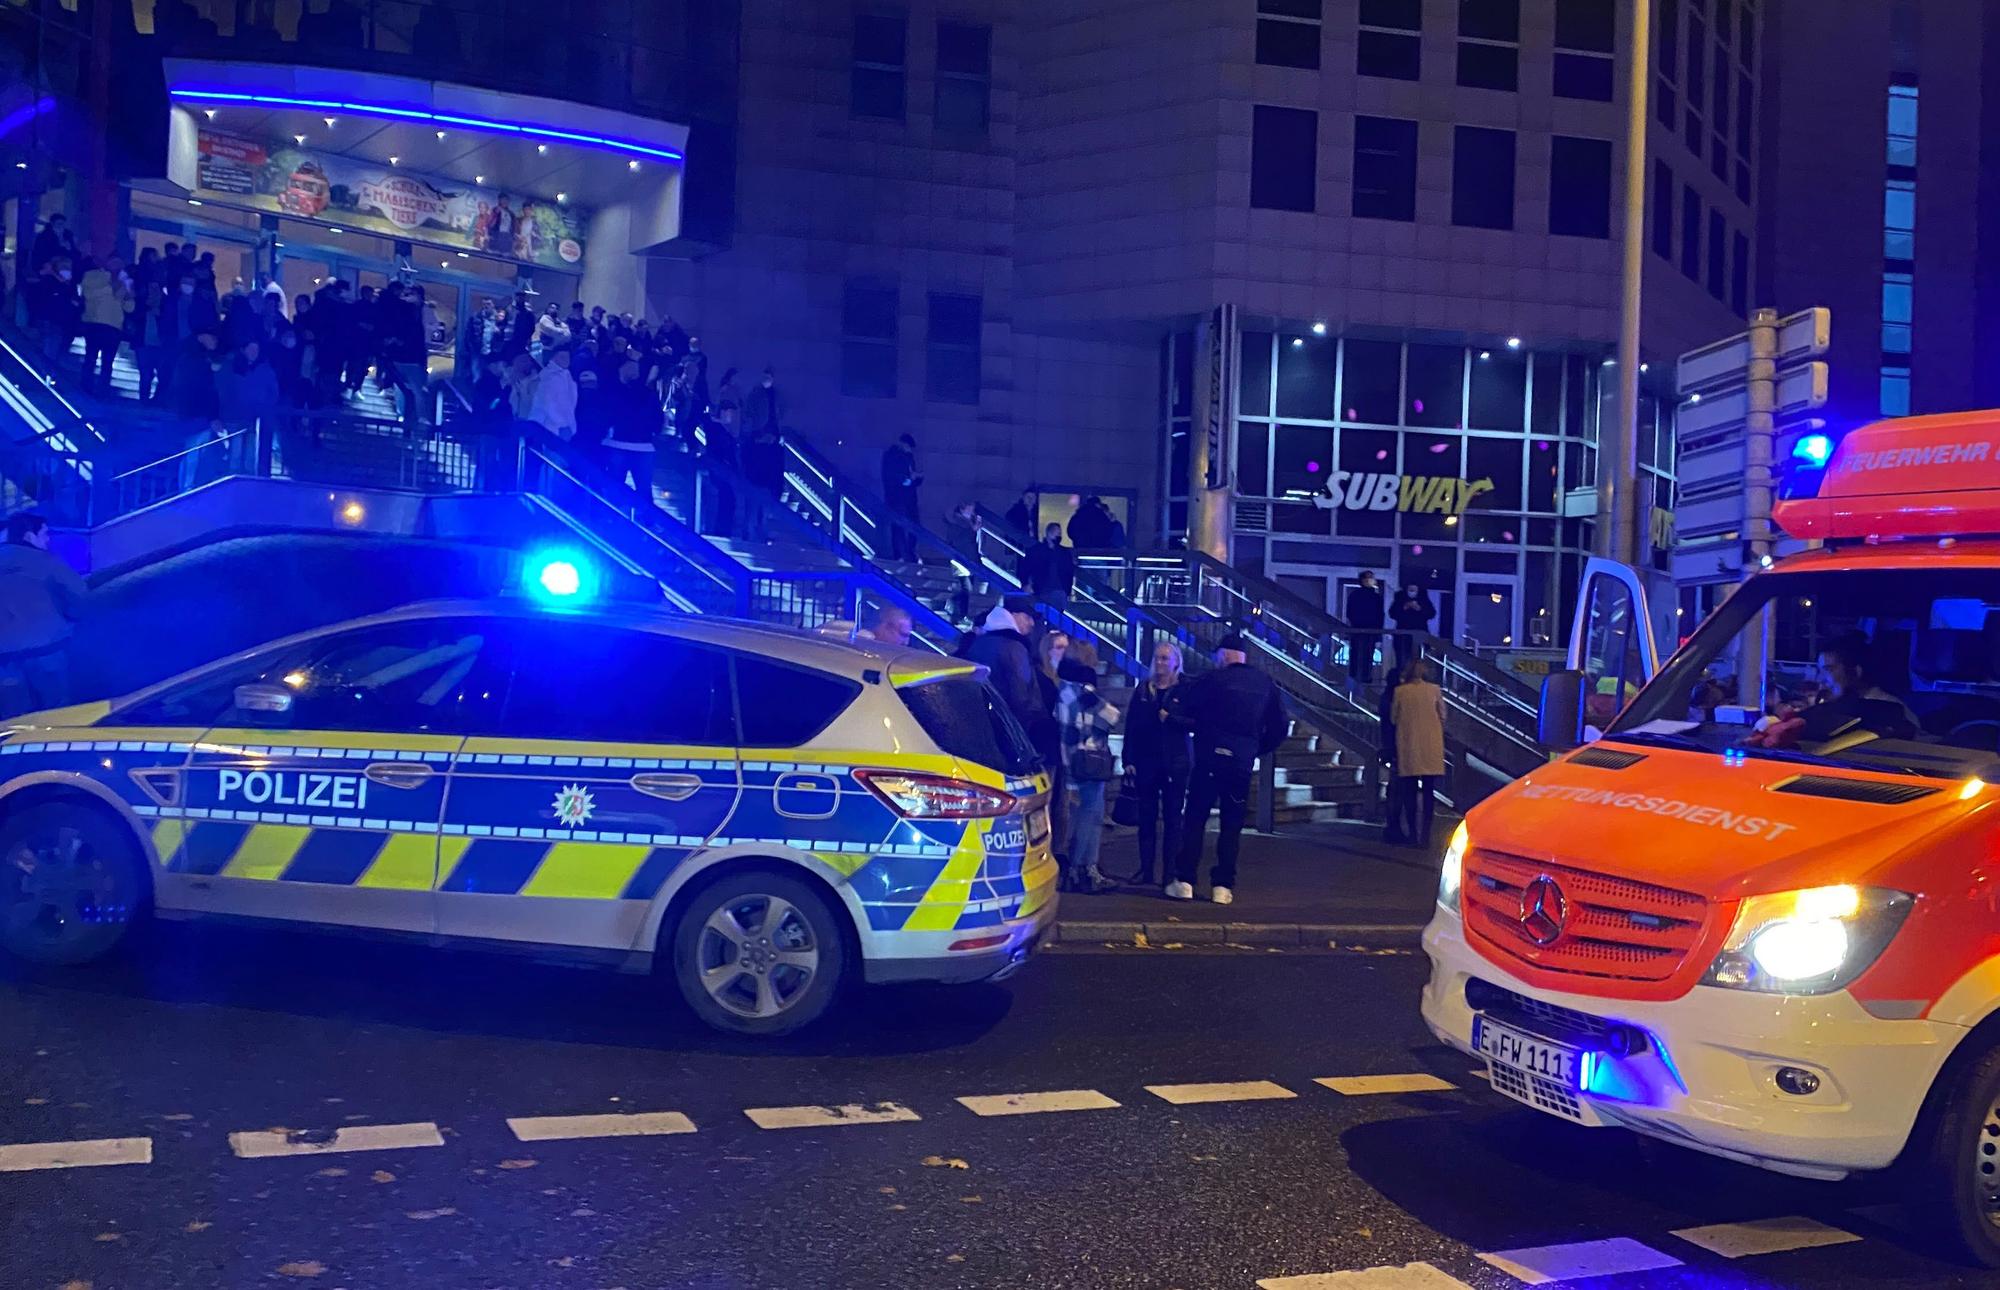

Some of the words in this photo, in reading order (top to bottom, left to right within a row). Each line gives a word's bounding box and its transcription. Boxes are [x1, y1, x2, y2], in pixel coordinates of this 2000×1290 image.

[1839, 441, 1991, 473] FEUERWEHR
[1313, 470, 1495, 514] SUBWAY
[218, 769, 368, 810] POLIZEI
[1516, 784, 1797, 842] RETTUNGSDIENST
[1480, 1025, 1490, 1051] E
[1500, 1034, 1522, 1063] FW
